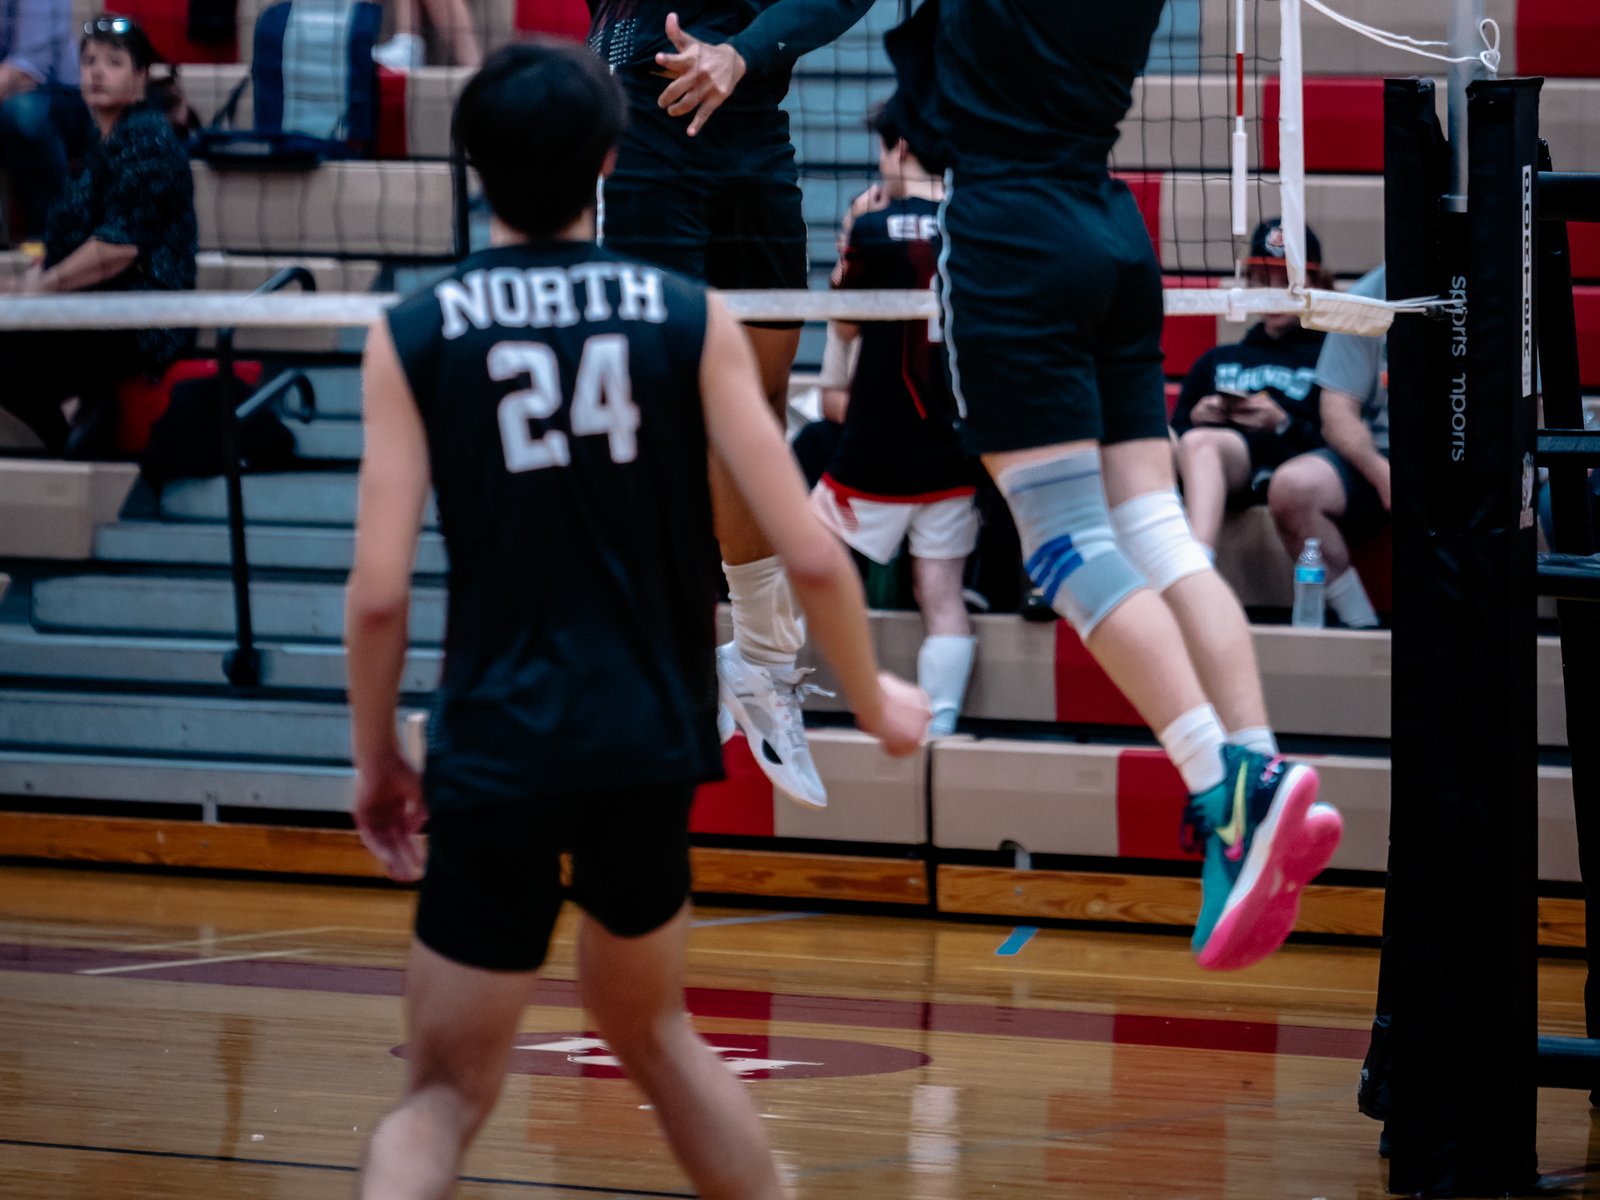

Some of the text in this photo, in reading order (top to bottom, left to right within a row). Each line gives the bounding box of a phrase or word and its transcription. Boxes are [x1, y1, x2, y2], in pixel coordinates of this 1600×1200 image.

[434, 262, 668, 339] NORTH
[1449, 275, 1468, 462] sports mports
[487, 333, 641, 473] 24
